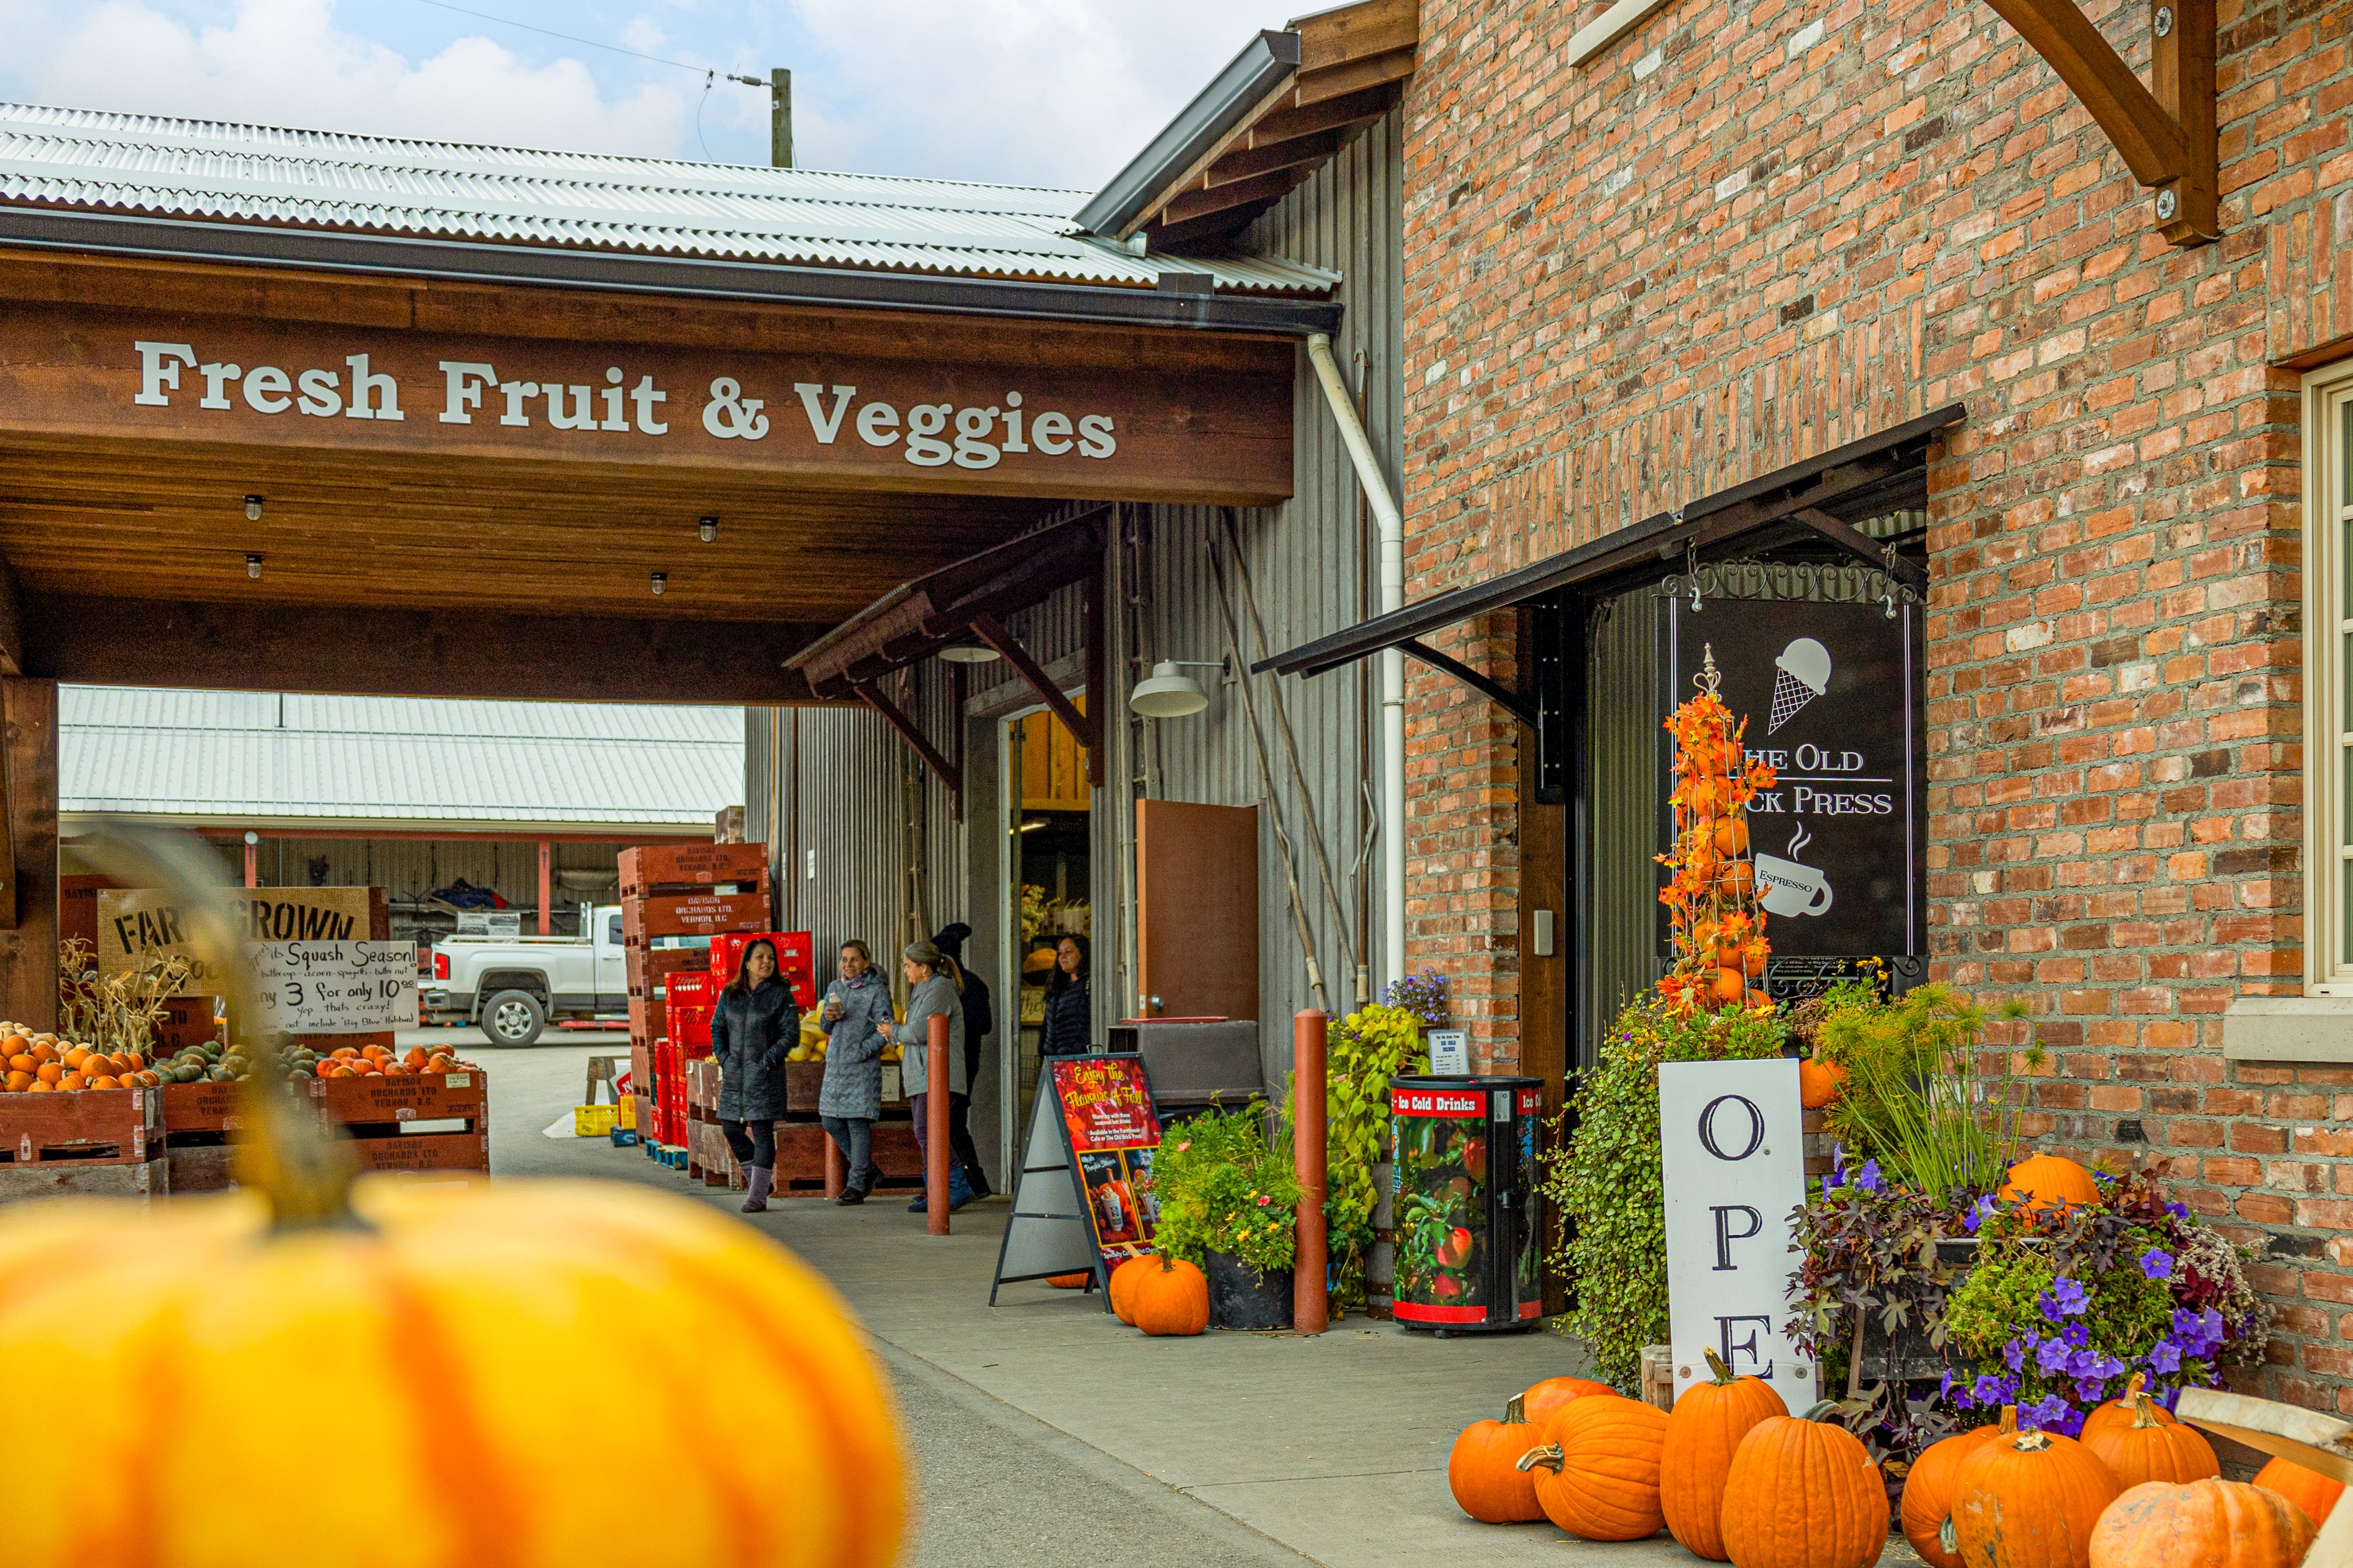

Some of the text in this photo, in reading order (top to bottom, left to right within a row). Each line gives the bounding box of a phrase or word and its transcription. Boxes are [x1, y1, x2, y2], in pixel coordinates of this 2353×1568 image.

[134, 340, 1117, 470] Fresh Fruit & Veggies
[1742, 743, 1864, 771] HE OLD
[1793, 786, 1893, 815] PRESS
[1759, 870, 1812, 893] ESPRESSO
[676, 906, 716, 915] ORCHARDS
[688, 896, 720, 905] DAVISON
[114, 907, 185, 955] FAR
[285, 942, 344, 971] Squash
[351, 941, 418, 968] Season!
[284, 982, 304, 1006] 3
[315, 982, 341, 1001] for
[347, 981, 372, 1002] only
[1074, 1063, 1125, 1090] Enjoy the
[1065, 1086, 1144, 1110] Flavours of Fall
[1398, 1095, 1409, 1109] Ice
[1412, 1096, 1431, 1110] Cold
[1436, 1097, 1476, 1111] Drinks
[1522, 1094, 1533, 1108] Ice
